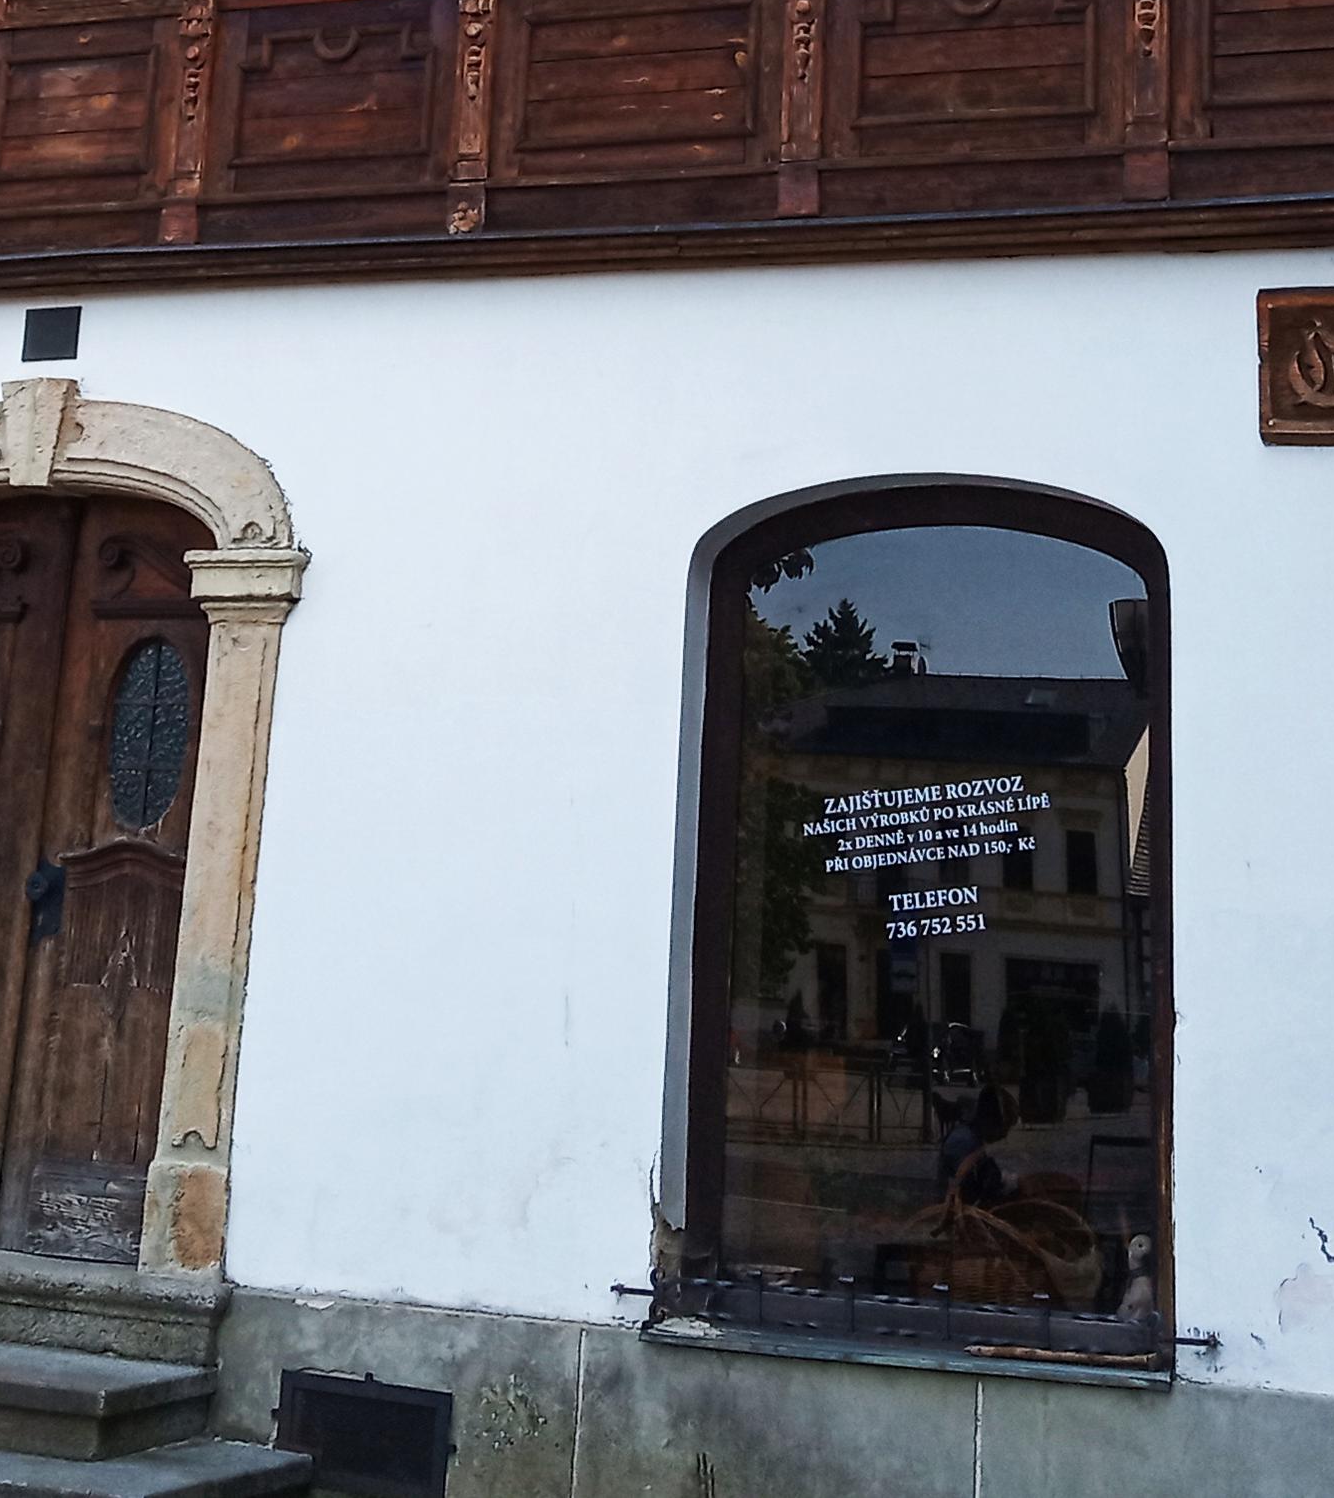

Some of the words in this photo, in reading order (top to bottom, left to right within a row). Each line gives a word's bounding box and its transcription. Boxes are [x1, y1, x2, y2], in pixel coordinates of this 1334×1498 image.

[824, 786, 942, 815] ZAJIŠŤUJEME
[946, 775, 1024, 800] ROZVOZ
[803, 816, 857, 837] NAŠICH
[859, 808, 930, 831] VÝROBKŮ
[933, 806, 954, 821] PO
[956, 797, 1015, 819] KRÁSNÉ
[1018, 792, 1051, 813] LÍPĚ
[837, 838, 853, 851] 2x
[855, 830, 905, 850] DENNĚ
[907, 833, 915, 843] v
[918, 829, 933, 843] 10
[935, 831, 943, 841] a
[945, 829, 960, 840] ve
[962, 824, 978, 837] 14
[979, 819, 1018, 835] hodin
[825, 855, 849, 873] PŘI
[852, 846, 945, 871] OBJEDNÁVCE
[948, 842, 980, 859] NAD
[1018, 836, 1036, 851] Kč
[888, 886, 978, 912] TELEFON
[886, 920, 917, 940] 736
[921, 917, 952, 936] 752
[956, 913, 986, 932] 551
